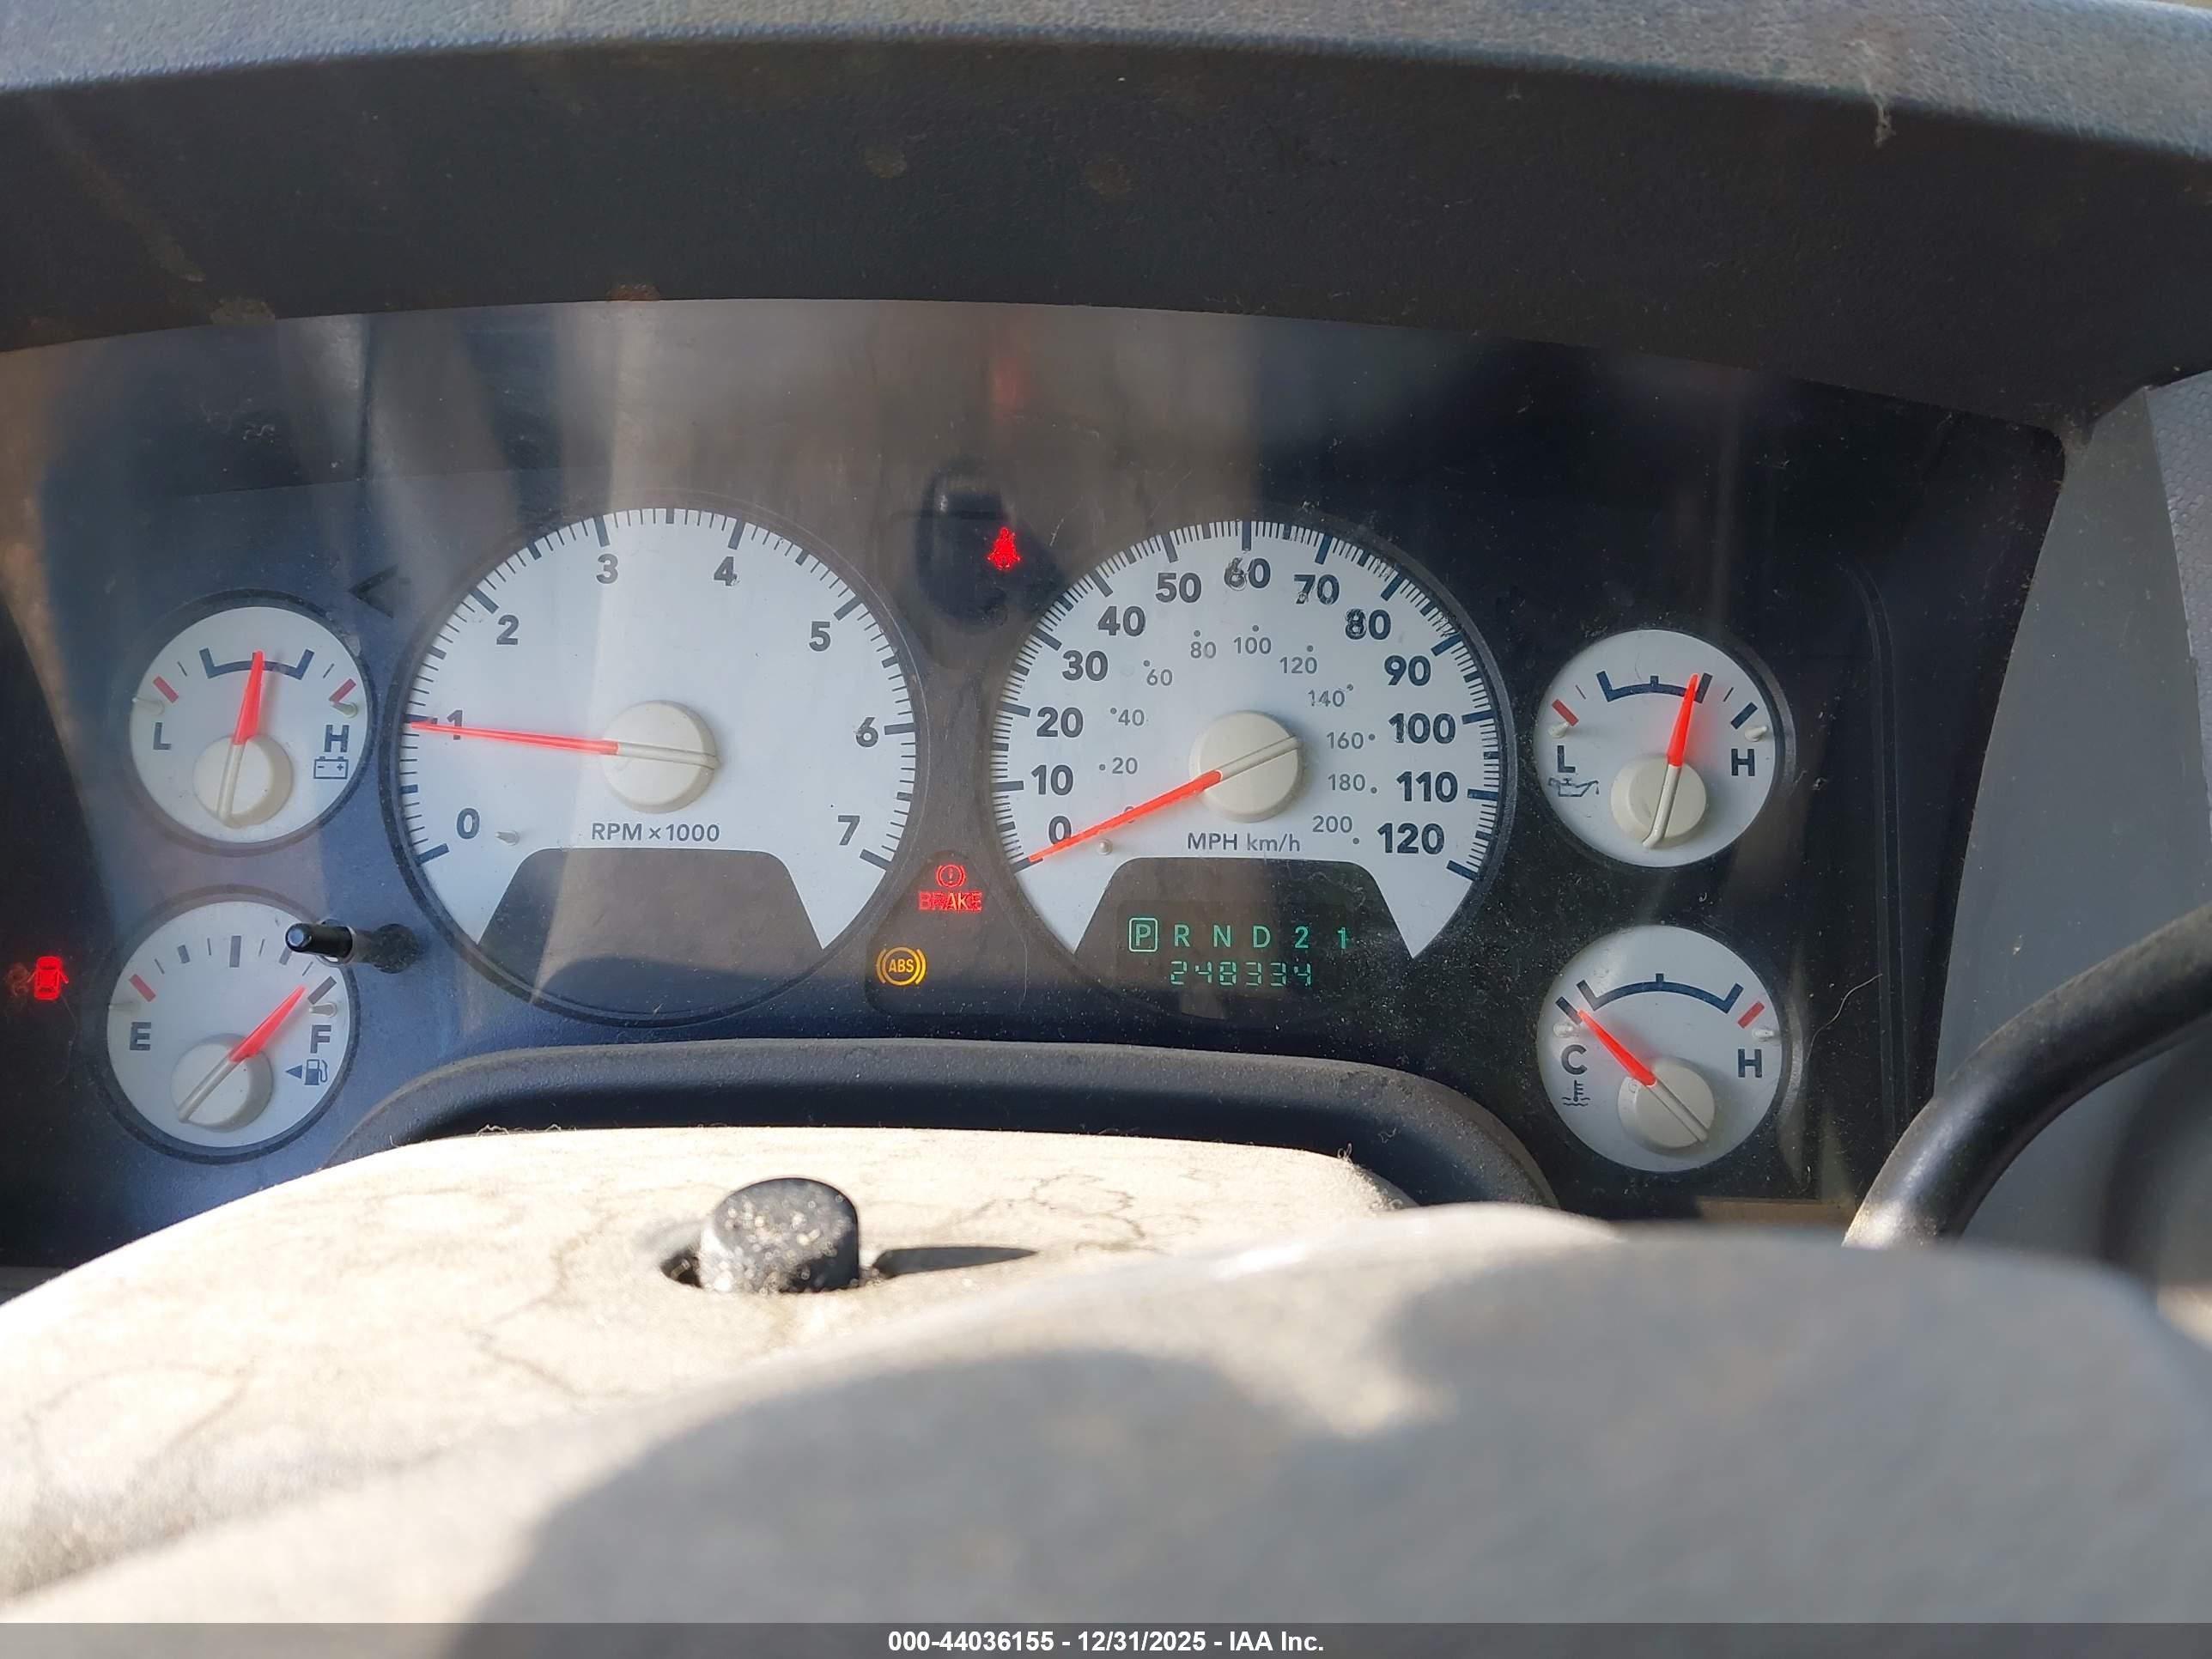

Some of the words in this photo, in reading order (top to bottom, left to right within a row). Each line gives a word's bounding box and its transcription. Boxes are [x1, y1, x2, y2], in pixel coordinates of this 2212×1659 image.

[596, 554, 618, 584] 3
[714, 556, 738, 586] 4
[1224, 558, 1271, 591] 60
[1156, 573, 1202, 603] 50
[1293, 574, 1340, 605] 70
[496, 615, 520, 646] 2
[1097, 606, 1146, 636] 40
[1345, 609, 1391, 641] 80
[809, 621, 831, 652] 5
[1190, 641, 1217, 659] 80
[1233, 636, 1272, 655] 100
[1062, 650, 1109, 681] 30
[1146, 668, 1173, 687] 60
[1279, 656, 1318, 675] 120
[1384, 655, 1431, 686] 90
[1308, 690, 1346, 708] 140
[447, 709, 463, 740] 1
[857, 717, 878, 747] 6
[1036, 707, 1083, 738] 20
[1117, 708, 1145, 726] 40
[1389, 714, 1456, 744] 100
[153, 721, 171, 750] L
[324, 725, 349, 753] H
[1327, 732, 1364, 750] 160
[1112, 757, 1138, 775] 20
[1557, 744, 1576, 773] L
[1731, 748, 1755, 777] H
[1031, 765, 1073, 795] 10
[1328, 773, 1366, 792] 180
[1396, 772, 1458, 803] 110
[456, 808, 480, 839] 0
[592, 823, 642, 841] RPM
[837, 816, 860, 846] 7
[1048, 815, 1072, 846] 0
[1312, 815, 1352, 834] 200
[1376, 823, 1444, 854] 120
[1188, 832, 1237, 851] MPH
[1247, 832, 1300, 853] km/h
[919, 891, 982, 911] BRAKE
[1134, 924, 1152, 946] P
[1174, 924, 1190, 947] R
[1213, 925, 1231, 948] N
[1253, 926, 1271, 948] D
[1294, 926, 1309, 949] 2
[1337, 927, 1346, 950] 1
[888, 958, 915, 973] ABS
[1170, 960, 1311, 988] 248334
[129, 1021, 151, 1051] E
[310, 1024, 331, 1054] F
[1561, 1044, 1587, 1075] C
[1738, 1048, 1762, 1079] H
